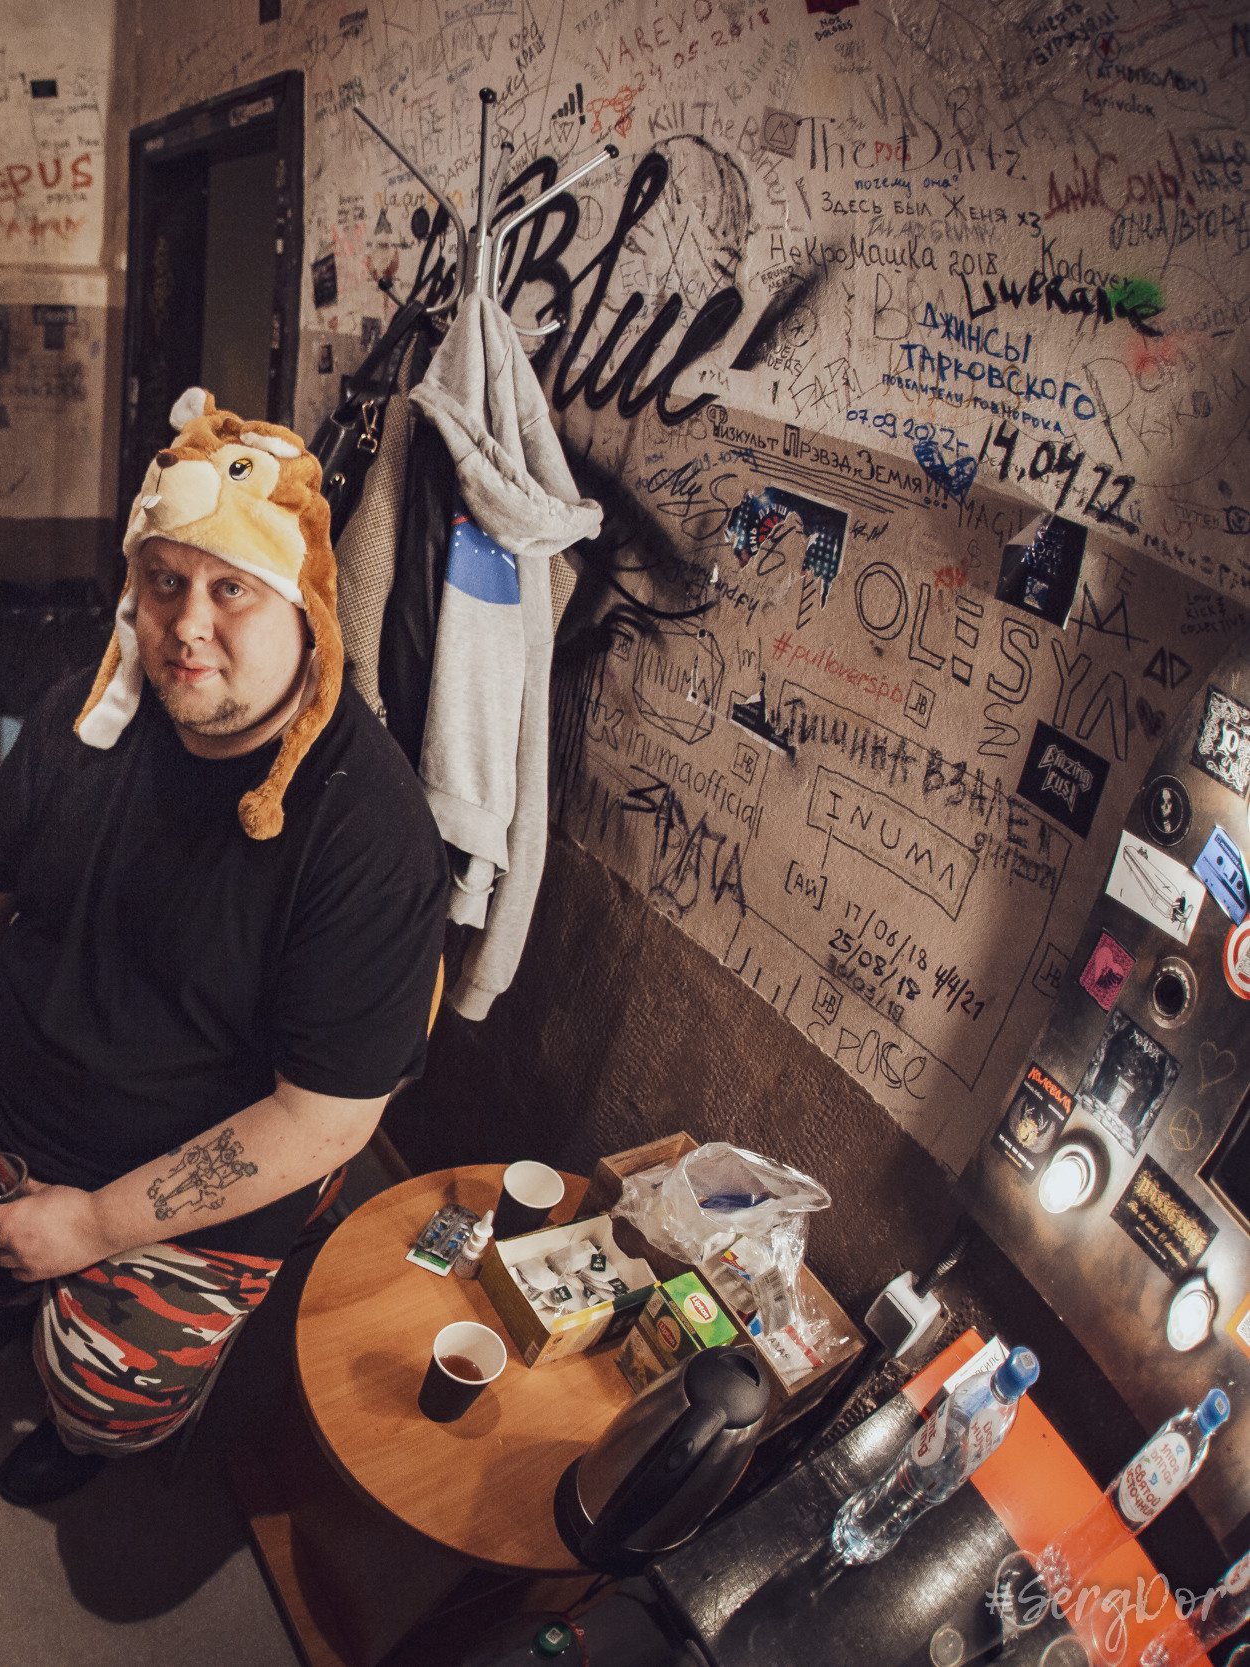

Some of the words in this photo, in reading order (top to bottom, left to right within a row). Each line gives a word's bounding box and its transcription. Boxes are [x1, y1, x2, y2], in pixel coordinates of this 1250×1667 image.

[821, 190, 884, 217] ЗДЕСЬ
[894, 201, 932, 218] БЫЛ
[949, 250, 1000, 279] 2018
[917, 301, 1033, 364] ДЖИНСЫ
[899, 342, 1099, 421] ТАРКОВСКОГО
[772, 632, 904, 703] #pulloverspb
[688, 1294, 713, 1321] Lipton
